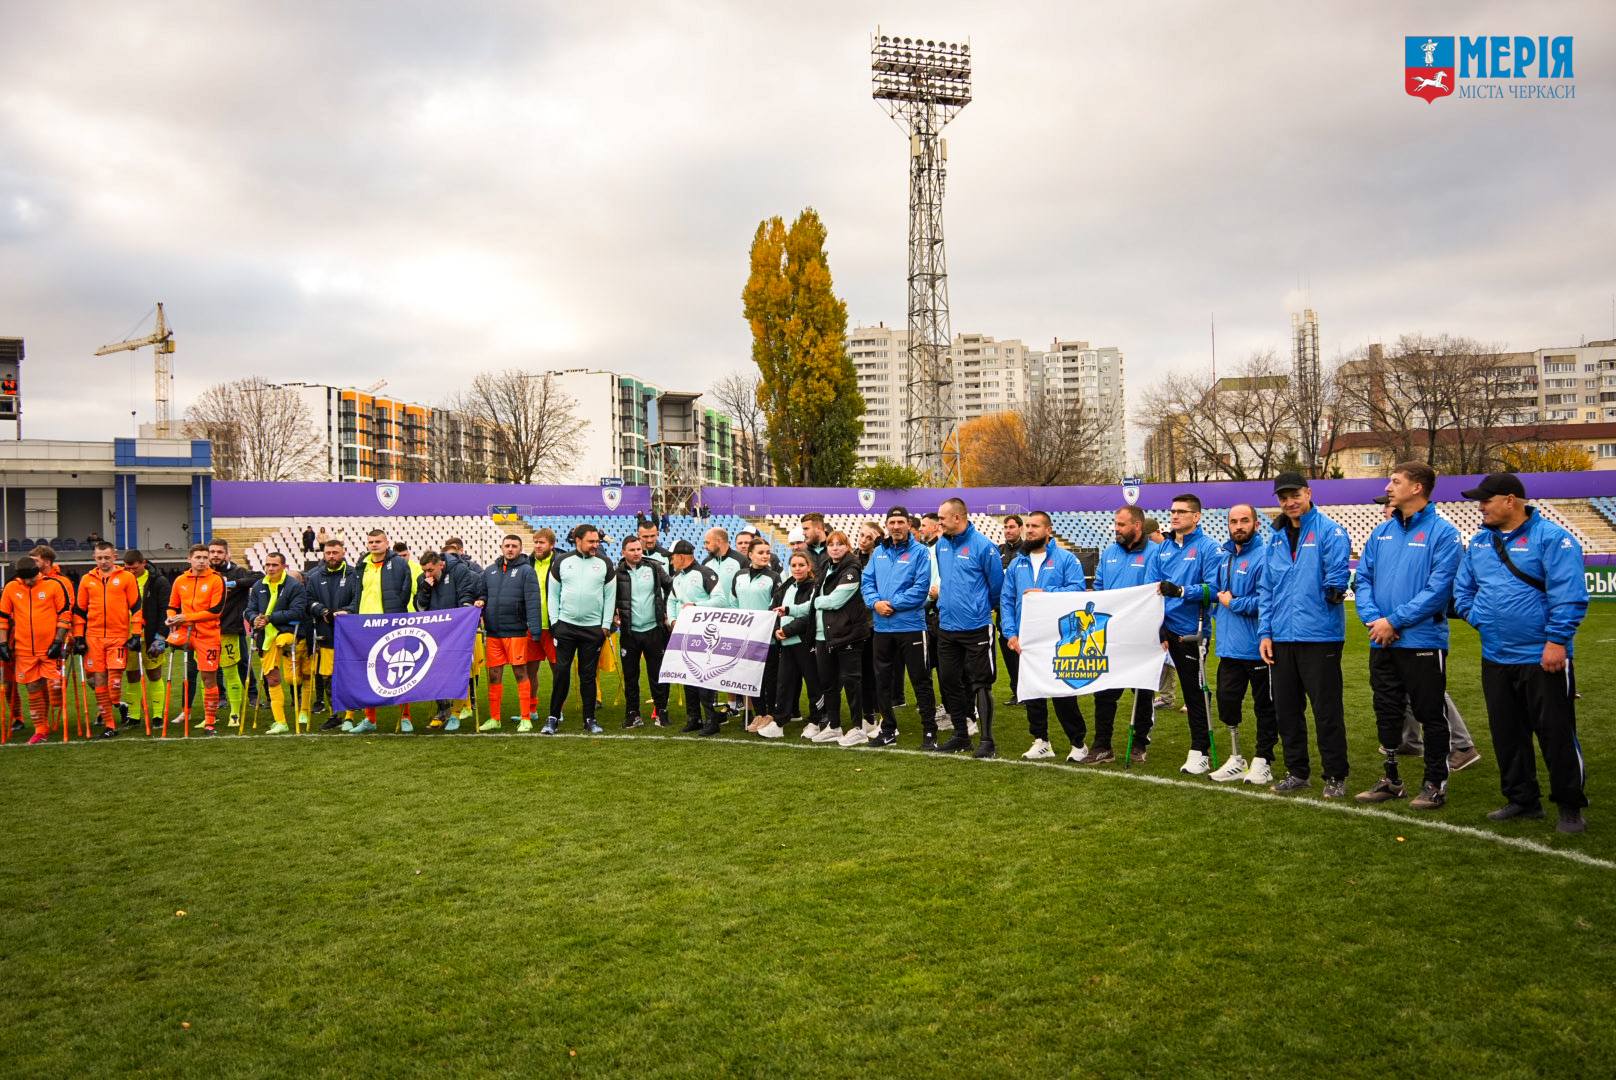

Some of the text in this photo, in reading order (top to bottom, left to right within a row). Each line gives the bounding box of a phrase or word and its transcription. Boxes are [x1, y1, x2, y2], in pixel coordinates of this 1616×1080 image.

[363, 613, 452, 627] AMP FOOTBALL
[692, 612, 754, 627] БУРЕВІЙ
[385, 629, 427, 642] ВІКІНГИ
[225, 644, 235, 655] 12
[691, 639, 732, 651] 20 25
[117, 647, 125, 659] 11
[207, 649, 217, 661] 29
[1054, 659, 1106, 671] ТИТАНИ
[1058, 671, 1099, 679] ЖИТОМИР
[375, 679, 418, 697] ТЕРНОПІЛЬ
[720, 679, 758, 692] ОБЛАСТЬ
